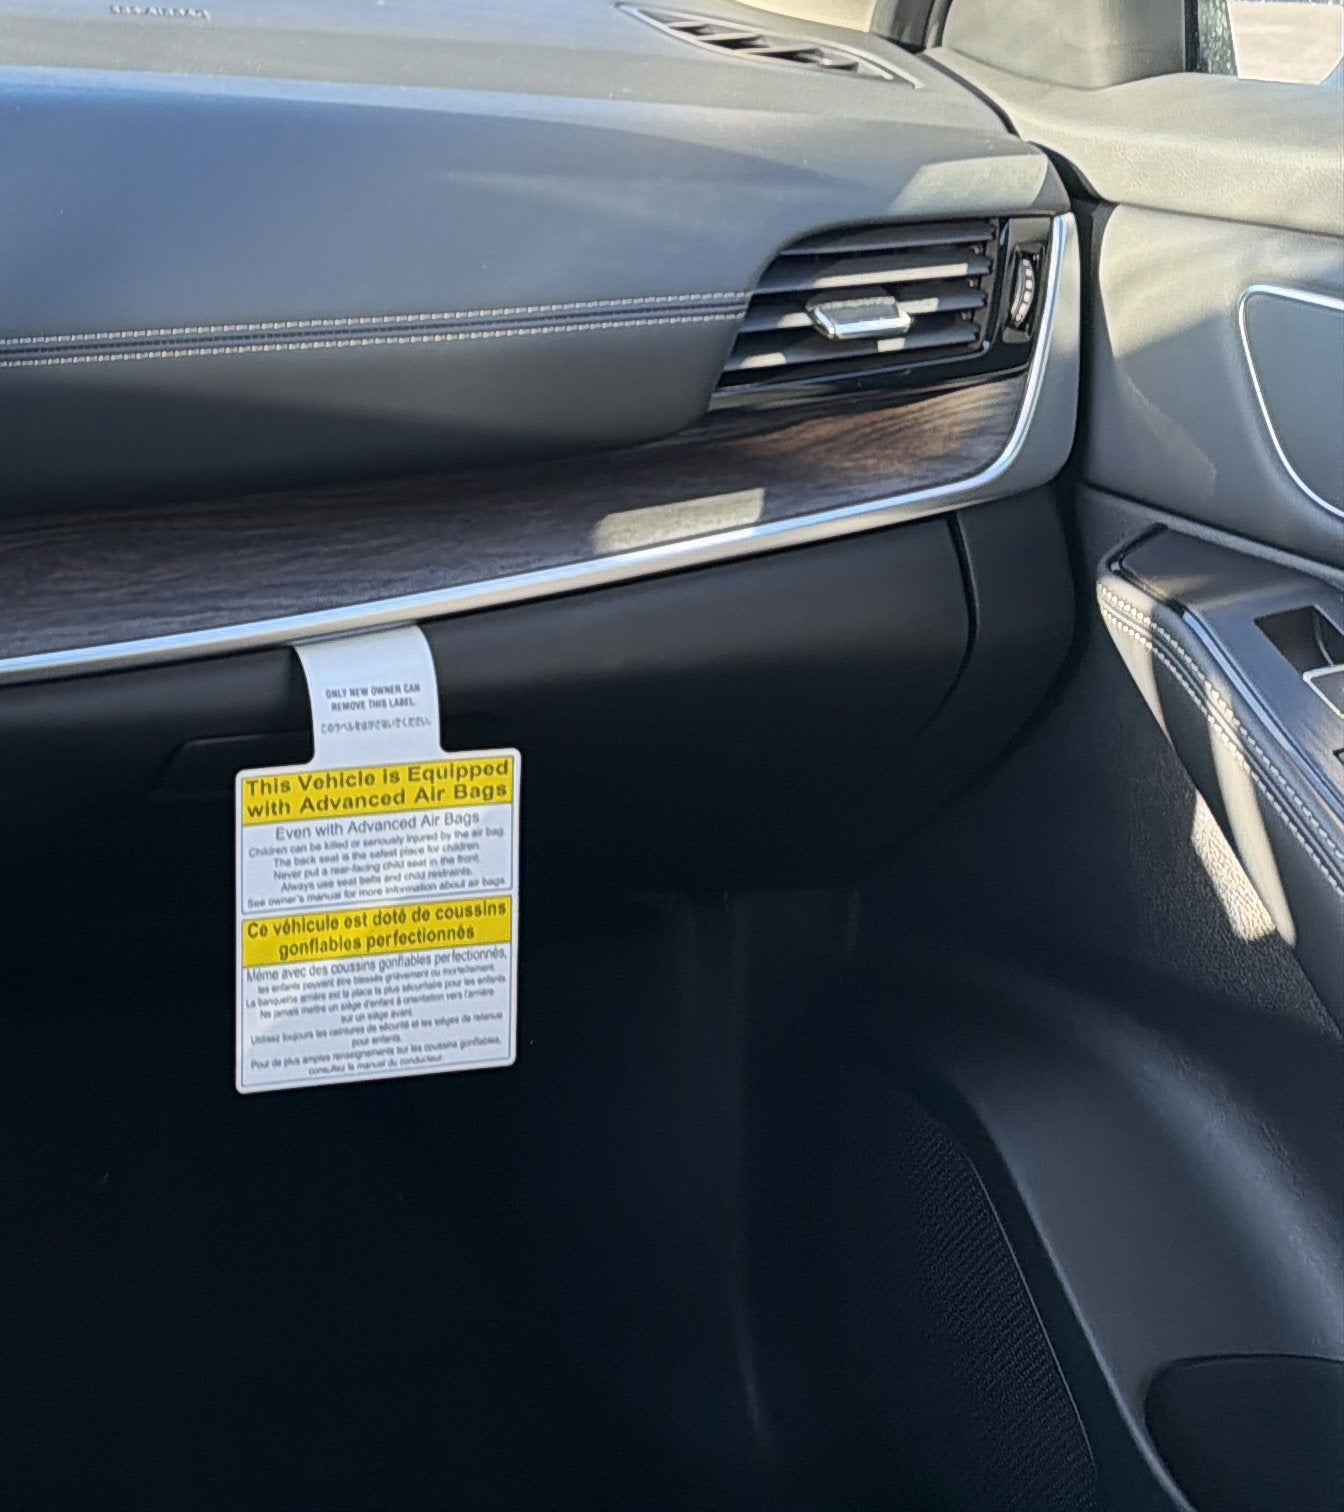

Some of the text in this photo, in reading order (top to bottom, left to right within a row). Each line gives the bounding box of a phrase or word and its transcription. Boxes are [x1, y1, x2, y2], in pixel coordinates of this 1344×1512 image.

[325, 684, 420, 698] ONLY NEW OWNER CAN
[331, 700, 365, 712] REMOVE
[368, 700, 386, 710] THIS
[246, 760, 508, 796] This Vehicle is Equipped
[247, 782, 506, 818] with Advanced Air Bags
[275, 812, 479, 841] Even with Advanced Air Bags
[247, 900, 505, 938] Ce véhicule est doté de coussins
[279, 925, 473, 960] gonflables perfectionnés
